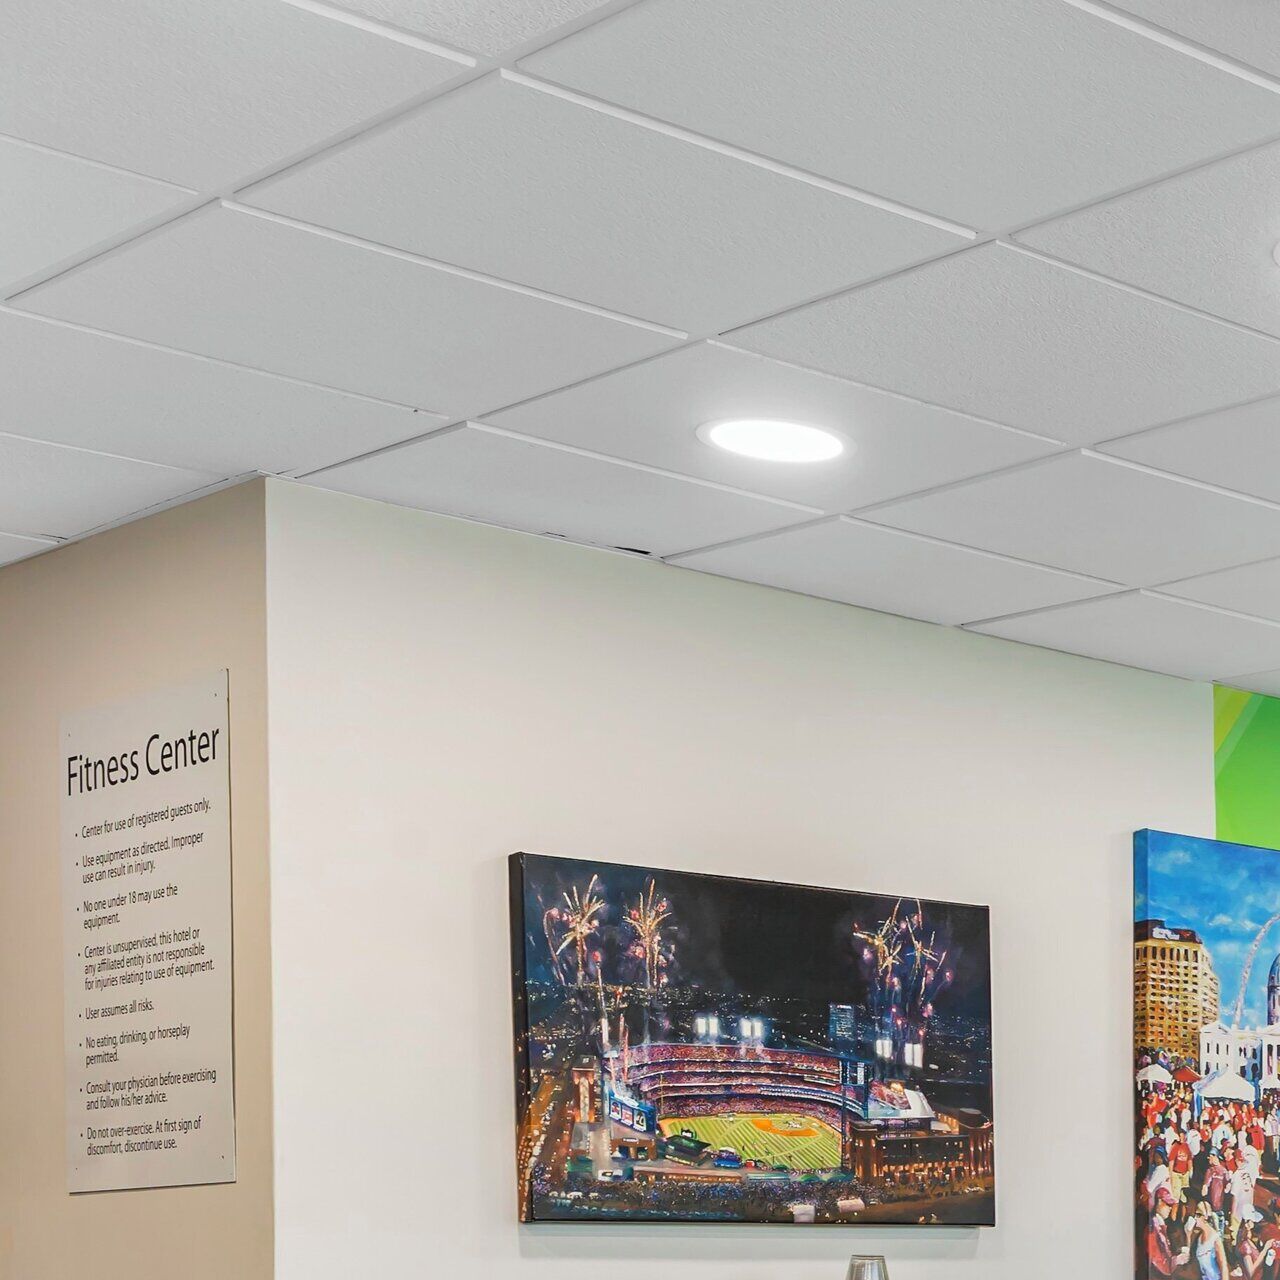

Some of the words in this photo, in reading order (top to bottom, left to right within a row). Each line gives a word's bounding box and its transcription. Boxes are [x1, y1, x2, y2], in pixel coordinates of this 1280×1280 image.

[67, 749, 139, 796] Fitness
[145, 728, 220, 776] Center
[81, 824, 103, 838] Center
[104, 819, 114, 834] for
[114, 819, 126, 831] use
[127, 814, 135, 828] of
[135, 805, 169, 828] registered
[170, 802, 193, 821] guests
[194, 797, 211, 814] only.
[82, 855, 95, 868] Use
[95, 847, 131, 865] equipment
[132, 846, 139, 857] as
[140, 836, 170, 855] directed.
[171, 831, 204, 850] Improper
[82, 872, 94, 884] use
[94, 869, 107, 882] can
[107, 863, 126, 879] result
[127, 862, 134, 874] in
[134, 859, 156, 875] injury.
[83, 900, 94, 913] No
[94, 899, 106, 911] one
[107, 893, 127, 909] under
[128, 891, 137, 904] 18
[137, 891, 151, 904] may
[153, 888, 165, 899] use
[166, 883, 178, 897] the
[83, 913, 120, 931] equipment.
[84, 945, 105, 958] Center
[106, 942, 112, 955] is
[112, 933, 158, 954] unsupervised,
[159, 931, 172, 945] this
[172, 926, 191, 943] hotel
[192, 928, 200, 940] or
[84, 963, 96, 976] any
[97, 956, 125, 973] affiliated
[126, 953, 145, 969] entity
[146, 952, 152, 964] is
[152, 951, 165, 963] not
[165, 942, 205, 963] responsible
[84, 978, 94, 991] for
[95, 974, 118, 992] injuries
[119, 970, 144, 986] relating
[145, 969, 152, 981] to
[153, 968, 165, 980] use
[166, 963, 175, 977] of
[175, 959, 215, 978] equipment.
[85, 1007, 100, 1020] User
[100, 1004, 128, 1018] assumes
[129, 1000, 137, 1014] all
[138, 997, 155, 1012] risks.
[85, 1036, 95, 1049] No
[96, 1034, 118, 1049] eating,
[119, 1030, 148, 1045] drinking,
[148, 1030, 156, 1041] or
[157, 1023, 191, 1040] horseplay
[86, 1050, 119, 1068] permitted.
[86, 1080, 111, 1094] Consult
[111, 1081, 127, 1095] your
[127, 1074, 159, 1092] physician
[159, 1071, 182, 1087] before
[182, 1068, 217, 1084] exercising
[86, 1096, 99, 1110] and
[99, 1094, 120, 1108] follow
[120, 1092, 143, 1107] his/her
[144, 1090, 168, 1104] advice.
[87, 1126, 98, 1139] Do
[97, 1126, 109, 1139] not
[155, 1120, 163, 1133] At
[164, 1118, 177, 1133] first
[178, 1118, 193, 1134] sign
[193, 1115, 202, 1130] of
[124, 1138, 163, 1153] discontinue
[163, 1137, 178, 1149] use.
